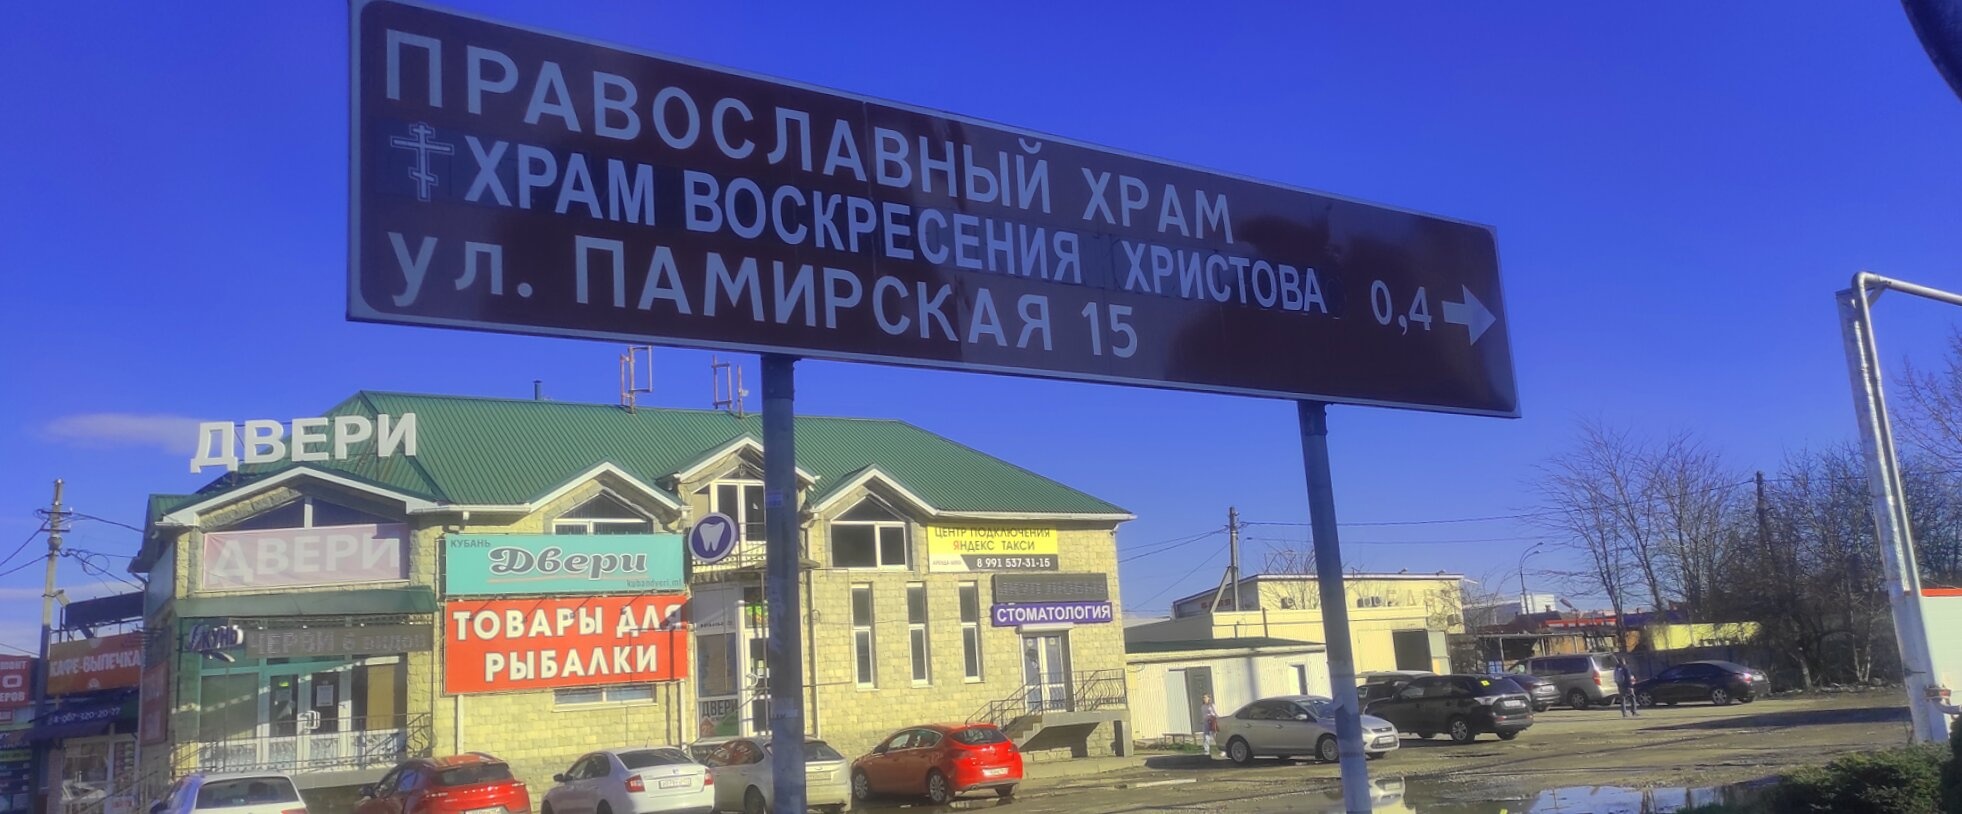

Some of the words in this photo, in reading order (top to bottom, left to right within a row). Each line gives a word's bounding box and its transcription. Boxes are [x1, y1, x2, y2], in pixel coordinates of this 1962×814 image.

[386, 29, 1051, 214] ПРАВОСЛАВНЫЙ
[1081, 167, 1234, 245] ХРАМ
[464, 135, 656, 227] ХРАМ
[683, 170, 1082, 283] ВОСКРЕСЕНИЯ
[1123, 241, 1328, 314] ХРИСТОВА
[387, 232, 534, 307] ул.
[574, 235, 1053, 351] ПАМИРСКАЯ
[1081, 302, 1138, 358] 15
[1370, 279, 1432, 335] 0,4
[190, 412, 416, 474] ДВЕРИ
[450, 538, 492, 549] КУБАНЬ
[935, 527, 967, 538] ЦЕНТР
[970, 526, 1051, 537] ПОДКЛЮЧЕНИЯ
[953, 540, 995, 552] ЯНДЕКС
[1001, 540, 1036, 551] ТАКСИ
[208, 533, 401, 585] ДВЕРИ
[488, 546, 648, 582] Двери
[976, 558, 983, 568] 8
[985, 558, 1003, 568] 991
[1005, 558, 1051, 568] 537-31-15
[452, 607, 603, 641] ТОВАРЫ
[616, 604, 684, 638] ДЛЯ
[996, 603, 1112, 623] СТОМАТОЛОГИЯ
[484, 645, 658, 682] РЫБАЛКИ
